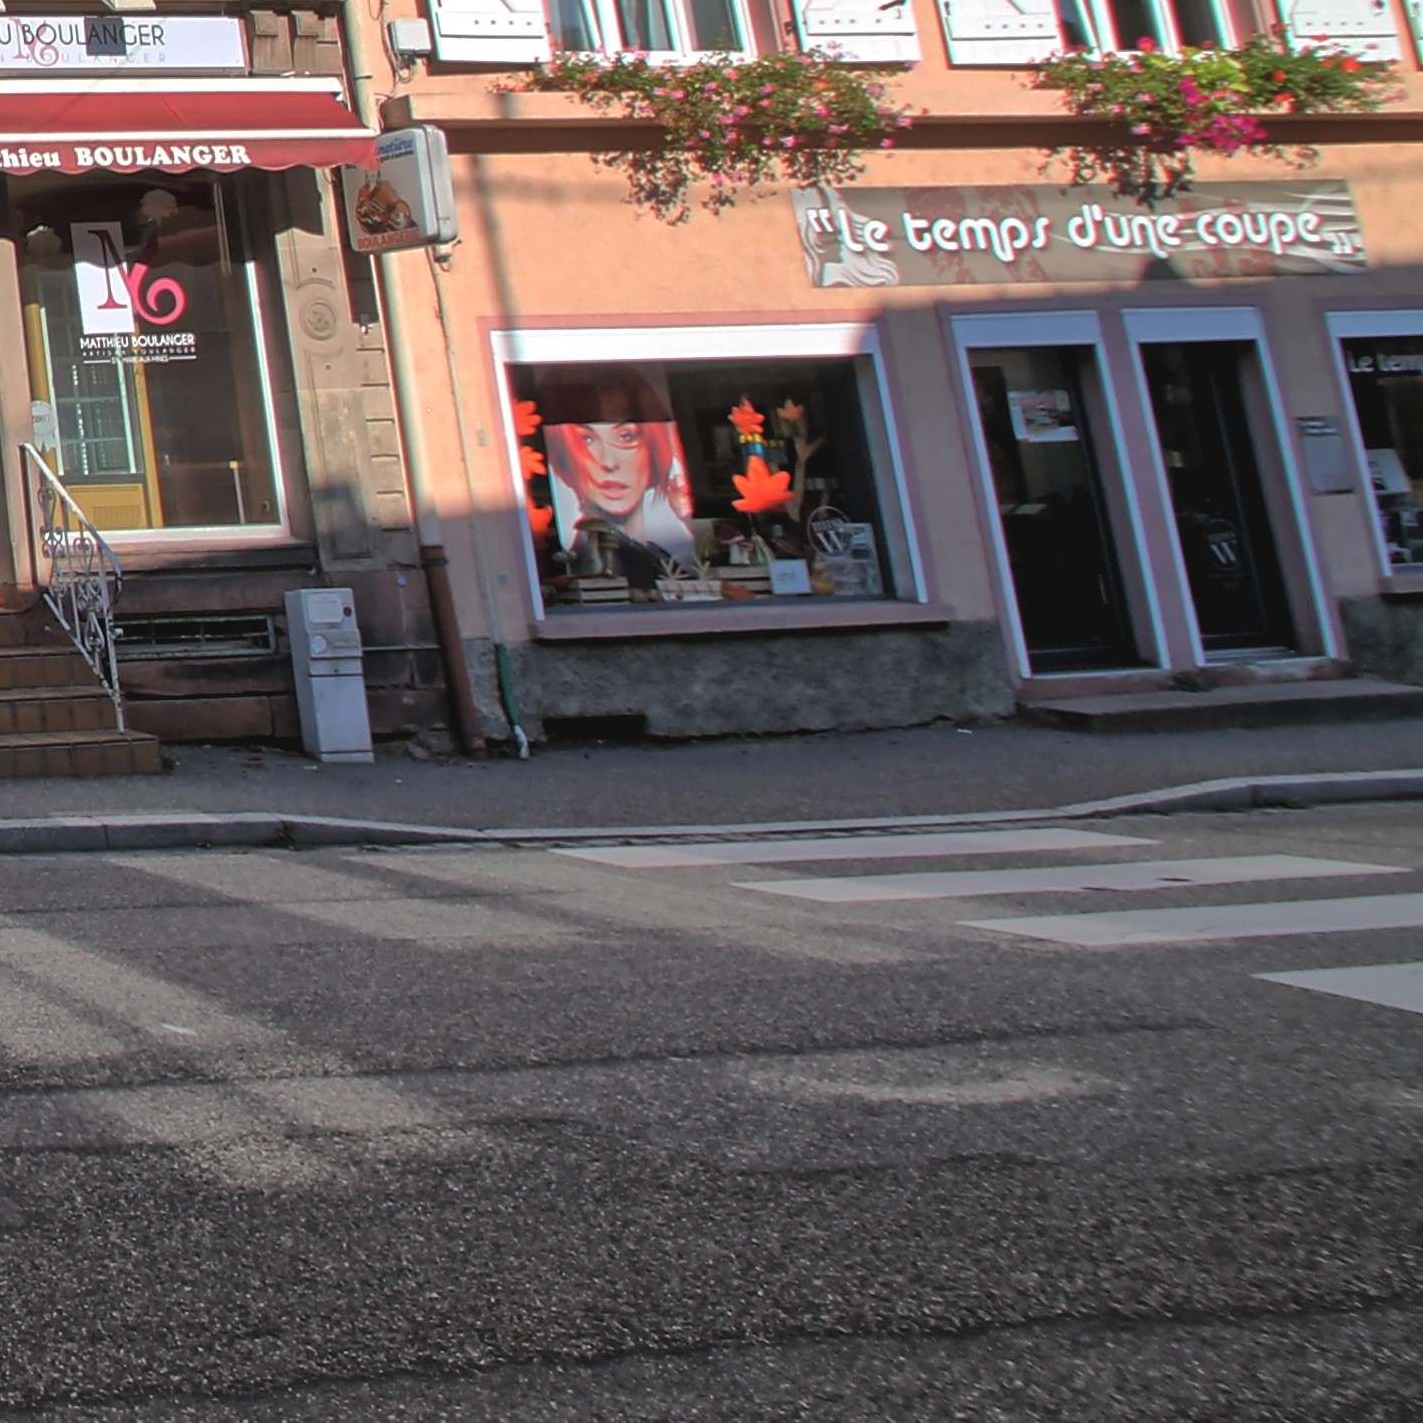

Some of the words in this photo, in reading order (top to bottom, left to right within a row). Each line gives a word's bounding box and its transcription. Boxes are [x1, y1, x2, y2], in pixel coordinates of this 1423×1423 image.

[21, 23, 165, 46] BOULANGER
[73, 145, 251, 167] BOULANGER
[903, 212, 1050, 262] temps
[1066, 204, 1181, 259] d'une
[80, 336, 129, 349] MATTHIEU
[131, 333, 195, 347] BOULANGER
